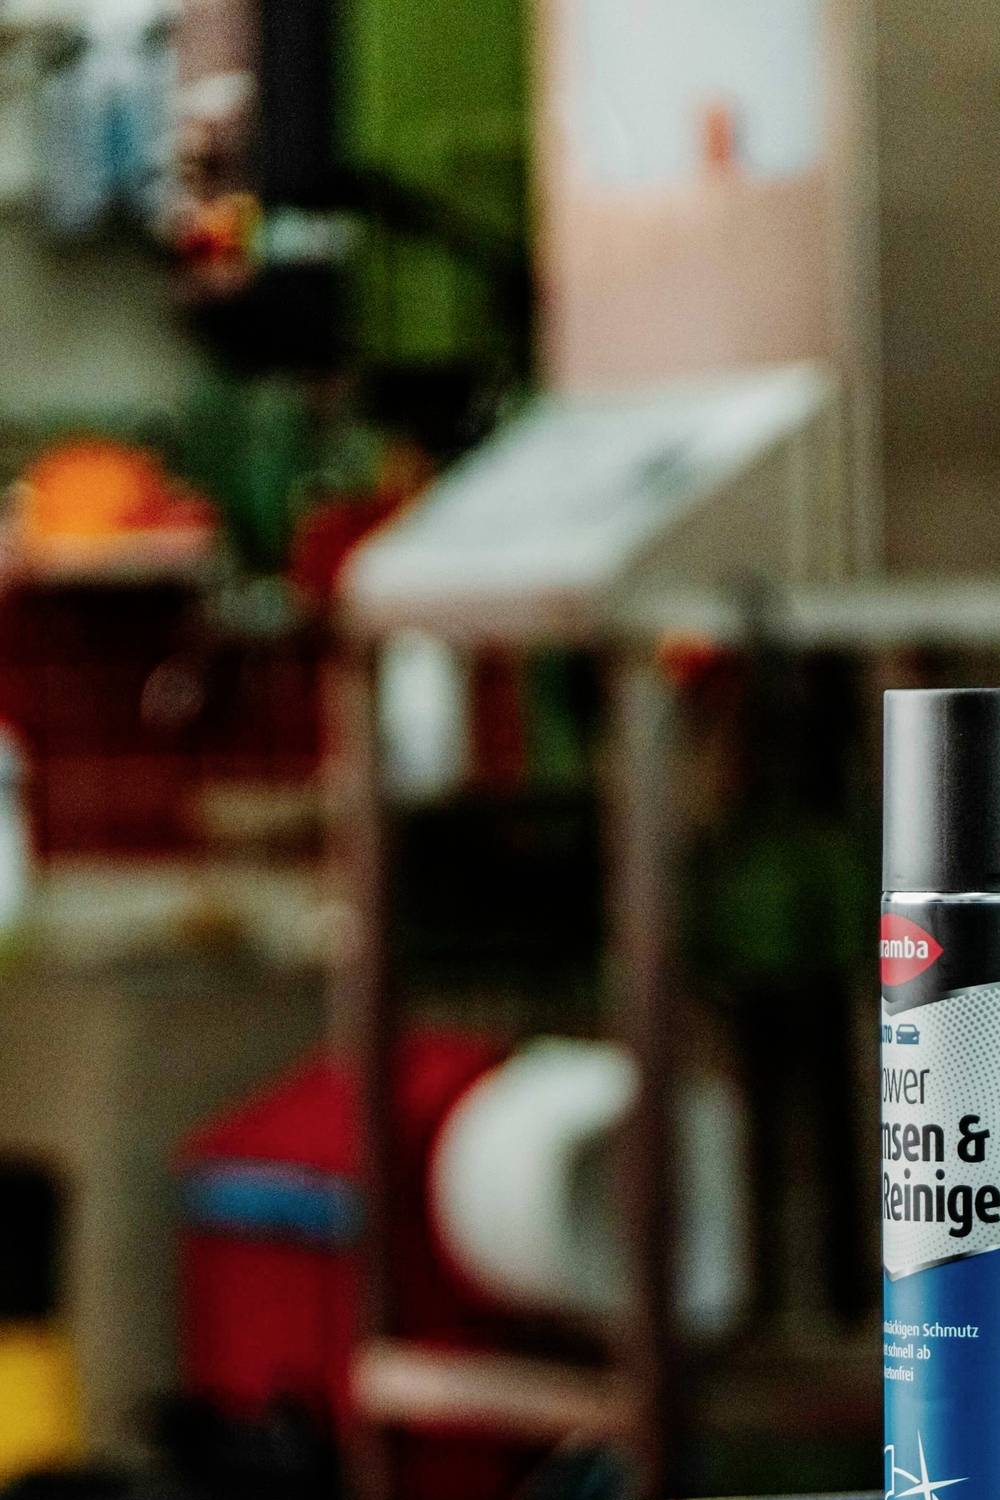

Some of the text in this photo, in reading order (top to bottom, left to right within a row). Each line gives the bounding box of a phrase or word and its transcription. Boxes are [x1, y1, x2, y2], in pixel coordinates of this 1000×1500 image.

[957, 1114, 991, 1163] &
[922, 1322, 979, 1338] Schmutz
[888, 1342, 913, 1358] schnell
[917, 1345, 931, 1360] ab
